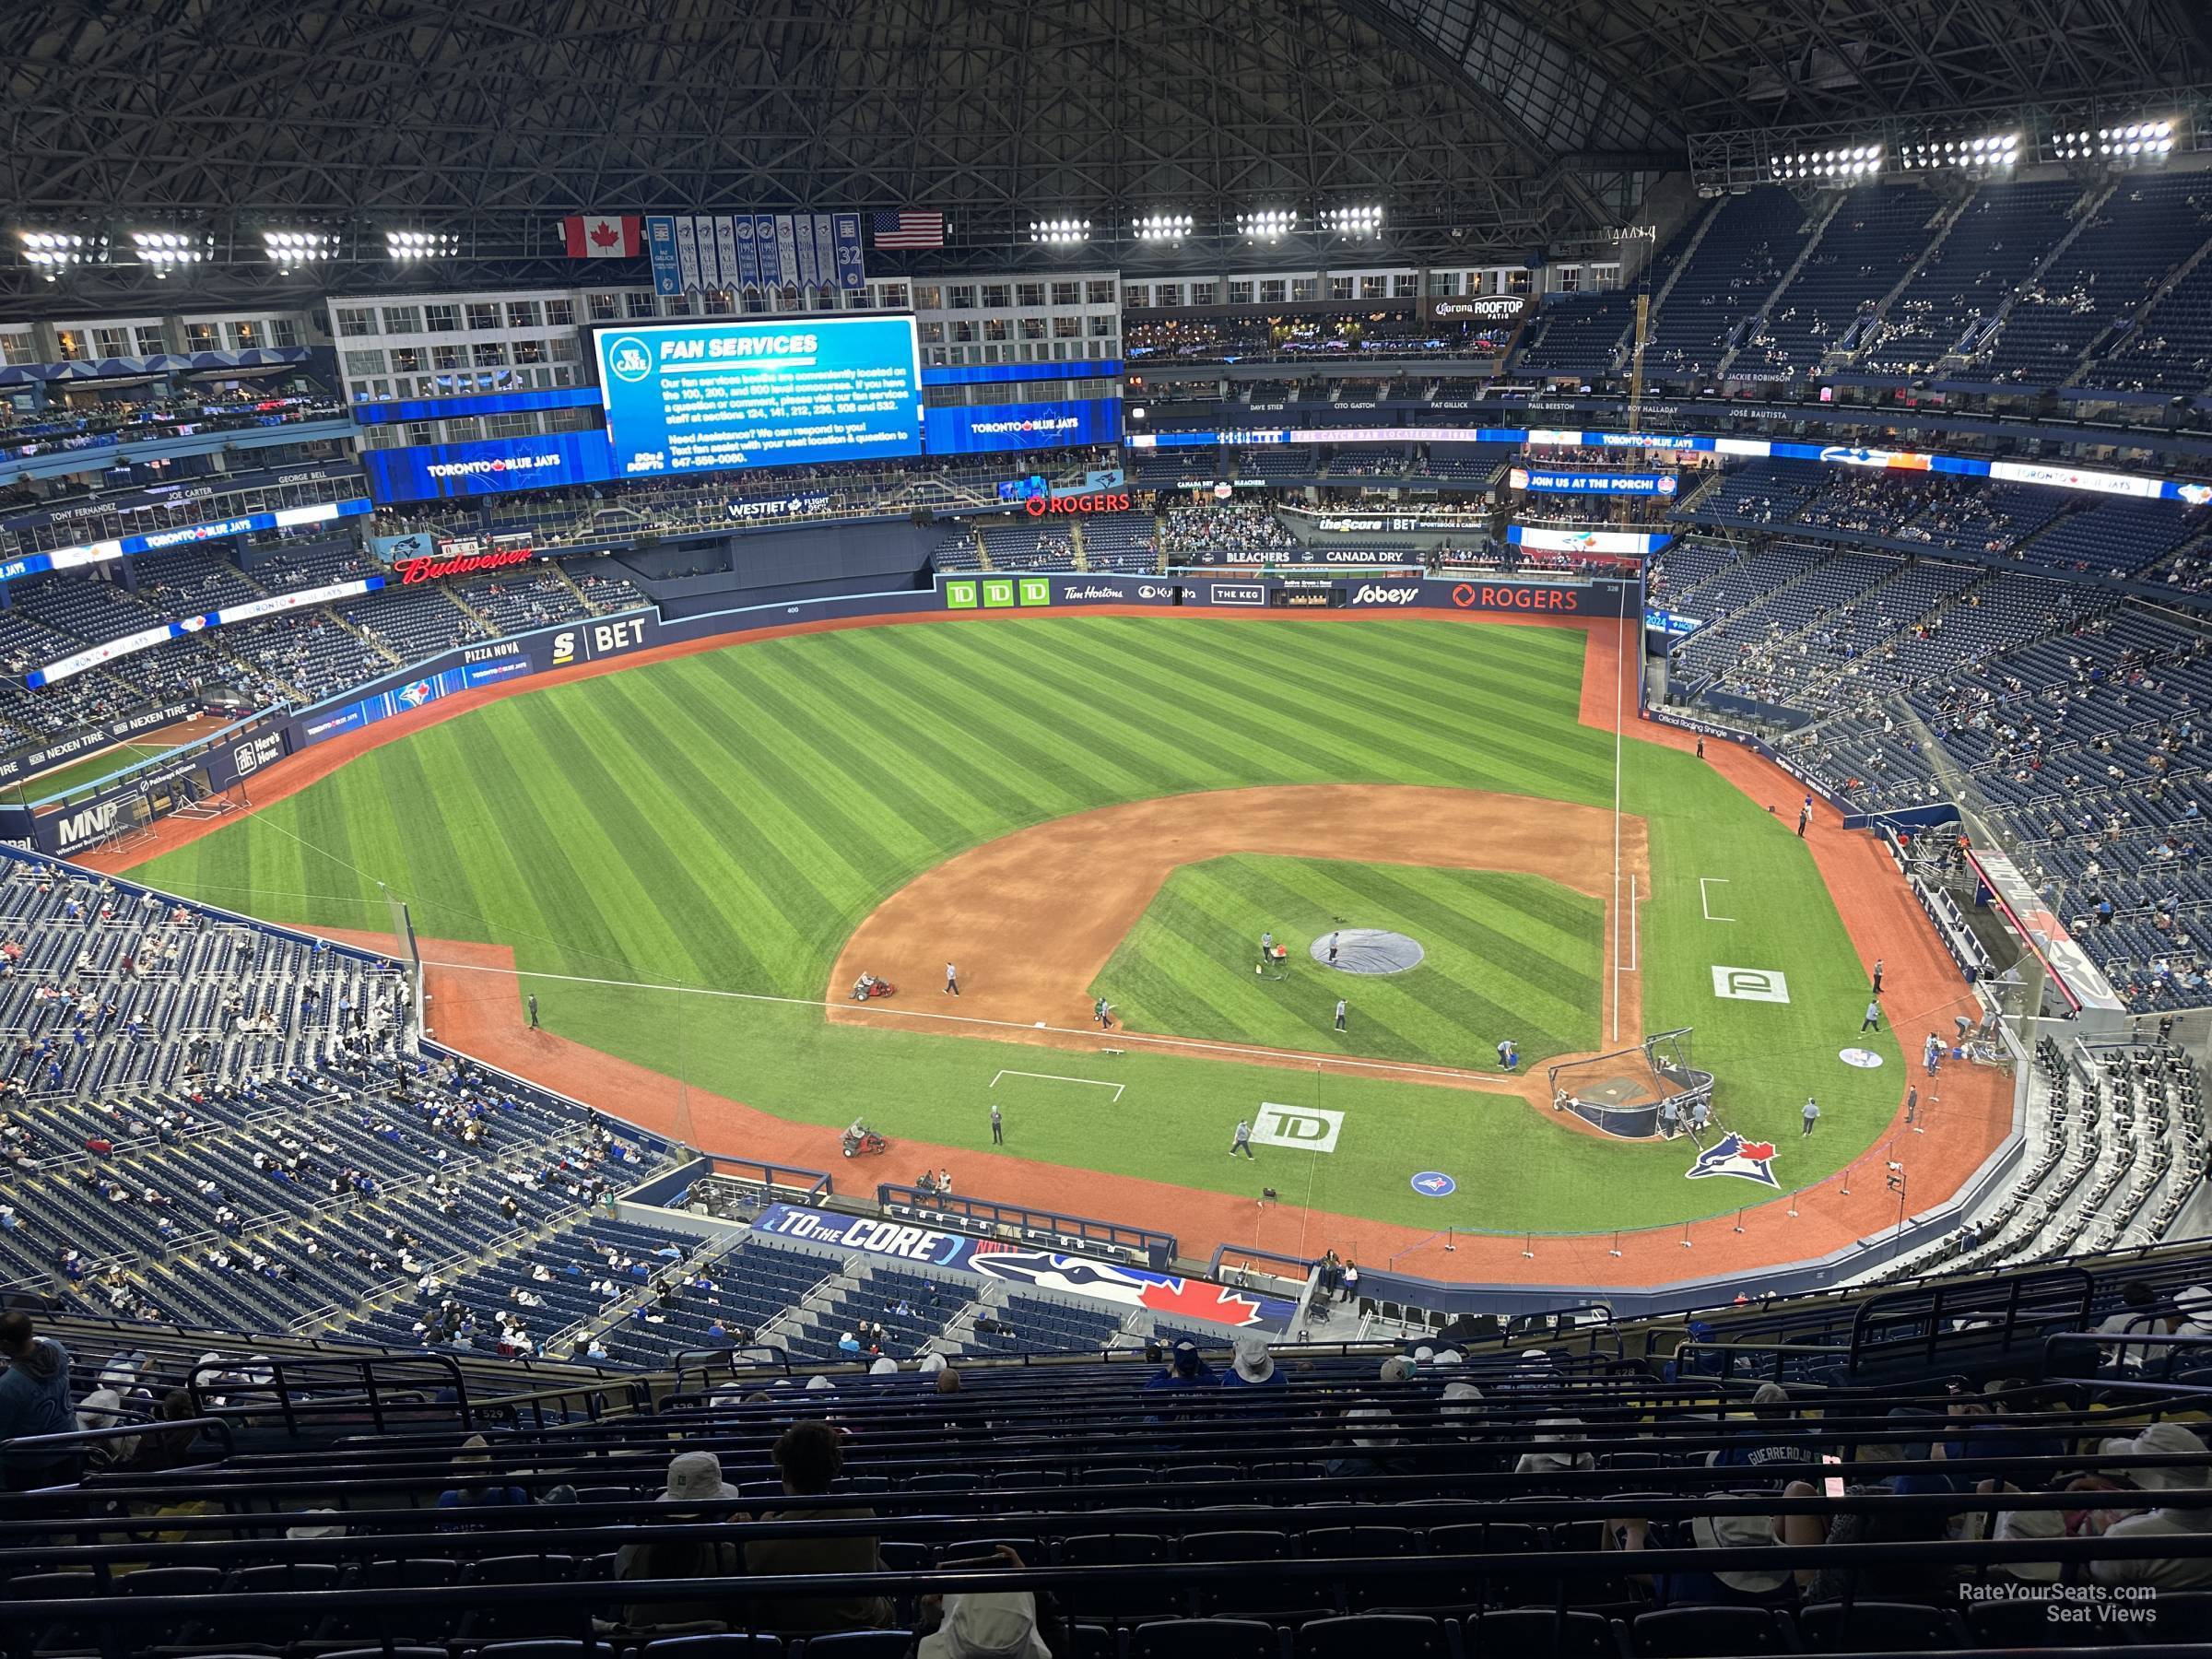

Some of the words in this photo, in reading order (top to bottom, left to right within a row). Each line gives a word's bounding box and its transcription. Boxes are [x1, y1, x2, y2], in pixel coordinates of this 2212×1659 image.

[839, 246, 862, 265] 32
[1436, 301, 1473, 316] Corona
[1475, 300, 1524, 313] ROOFTOP
[660, 340, 706, 360] FAN
[709, 334, 818, 359] SERVICES
[661, 378, 680, 388] Our
[681, 377, 699, 387] fan
[699, 375, 741, 386] services
[778, 372, 794, 382] are
[795, 369, 855, 381] conveniently
[857, 368, 893, 379] located
[1727, 372, 1751, 382] JACKIE
[1752, 373, 1791, 382] ROBINSON
[663, 391, 680, 400] the
[730, 386, 749, 396] and
[771, 383, 794, 394] level
[864, 380, 882, 390] you
[882, 378, 906, 388] have
[665, 405, 672, 413] a
[672, 401, 716, 414] question
[717, 401, 728, 409] or
[781, 395, 812, 406] please
[814, 394, 833, 403] visit
[834, 393, 851, 402] our
[853, 391, 868, 400] fan
[869, 390, 910, 400] services
[1267, 403, 1284, 411] STIEB
[1334, 402, 1348, 410] CITO
[1443, 401, 1468, 409] GILLICK
[1528, 402, 1544, 410] PAUL
[1545, 402, 1575, 410] BEESTON
[1642, 406, 1678, 414] HALLADAY
[665, 414, 690, 424] staff
[691, 413, 701, 422] at
[702, 410, 745, 422] sections
[857, 402, 876, 412] and
[1728, 408, 1748, 418] JOSÉ
[1751, 410, 1787, 419] BAUTISTA
[668, 433, 696, 444] Need
[696, 430, 755, 442] Assistance?
[757, 429, 773, 439] We
[773, 427, 792, 437] can
[794, 423, 833, 436] respond
[834, 423, 844, 433] to
[971, 421, 1022, 434] TORONTO
[1032, 419, 1056, 430] BLUE
[1056, 418, 1079, 429] JAYS
[669, 446, 692, 455] Text
[692, 444, 710, 453] fan
[711, 441, 739, 453] assist
[740, 440, 761, 450] with
[762, 438, 785, 451] your
[785, 436, 806, 447] seat
[807, 433, 846, 446] location
[847, 433, 855, 442] &
[855, 431, 897, 444] question
[898, 431, 908, 440] to
[1603, 434, 1643, 446] TORONTO
[1653, 438, 1673, 447] BLUE
[1673, 438, 1694, 448] JAYS
[427, 461, 491, 477] TORONTO
[504, 455, 532, 470] BLUE
[534, 453, 560, 467] JAYS
[278, 473, 309, 484] GEORGE
[310, 470, 327, 480] BELL
[1531, 476, 1554, 488] JOIN
[1556, 477, 1570, 488] US
[1571, 477, 1586, 488] AT
[1589, 478, 1608, 488] THE
[168, 491, 182, 501] JOE
[184, 487, 214, 499] CARTER
[804, 497, 830, 506] FLIGHT
[1049, 493, 1130, 513] ROGERS
[50, 511, 73, 523] TONY
[75, 502, 117, 518] FERNANDEZ
[728, 500, 787, 516] WESTJET
[1319, 515, 1382, 530] theScore
[1393, 518, 1418, 530] BET
[145, 528, 196, 547] TORONTO
[206, 523, 229, 536] BLUE
[230, 519, 252, 533] JAYS
[394, 547, 532, 584] Budweiser
[1227, 551, 1290, 563] BLEACHERS
[1326, 552, 1377, 562] CANADA
[6, 561, 26, 577] JAYS
[950, 586, 974, 603] TD
[986, 584, 1010, 602] TD
[1022, 583, 1046, 600] TD
[1064, 586, 1084, 600] Tim
[1084, 585, 1124, 599] Hortons
[1218, 590, 1237, 598] THE
[1239, 591, 1259, 599] KEG
[1352, 584, 1418, 605] Sobeys
[1481, 587, 1578, 610] ROGERS
[1646, 615, 1666, 628] 2024
[594, 618, 645, 652] BET
[465, 648, 493, 664] PIZZA
[495, 641, 520, 657] NOVA
[554, 632, 575, 658] S
[130, 712, 164, 730] NEXEN
[165, 703, 188, 718] TIRE
[1658, 713, 1680, 724] Official
[1680, 720, 1704, 734] Roofing
[1704, 724, 1728, 738] Shingle
[47, 741, 82, 760] NEXEN
[81, 731, 105, 747] TIRE
[254, 732, 281, 752] Here's
[257, 747, 279, 765] How.
[149, 772, 175, 787] Pathways
[175, 763, 196, 776] Alliance
[59, 802, 118, 846] MNP
[55, 842, 84, 856] Wherever
[1727, 971, 1772, 994] TD
[1267, 1111, 1331, 1141] TD
[777, 1211, 820, 1237] TO
[814, 1227, 843, 1242] THE
[840, 1218, 947, 1261] CORE
[482, 1408, 504, 1419] 529
[1747, 1446, 1800, 1466] GUERRERO
